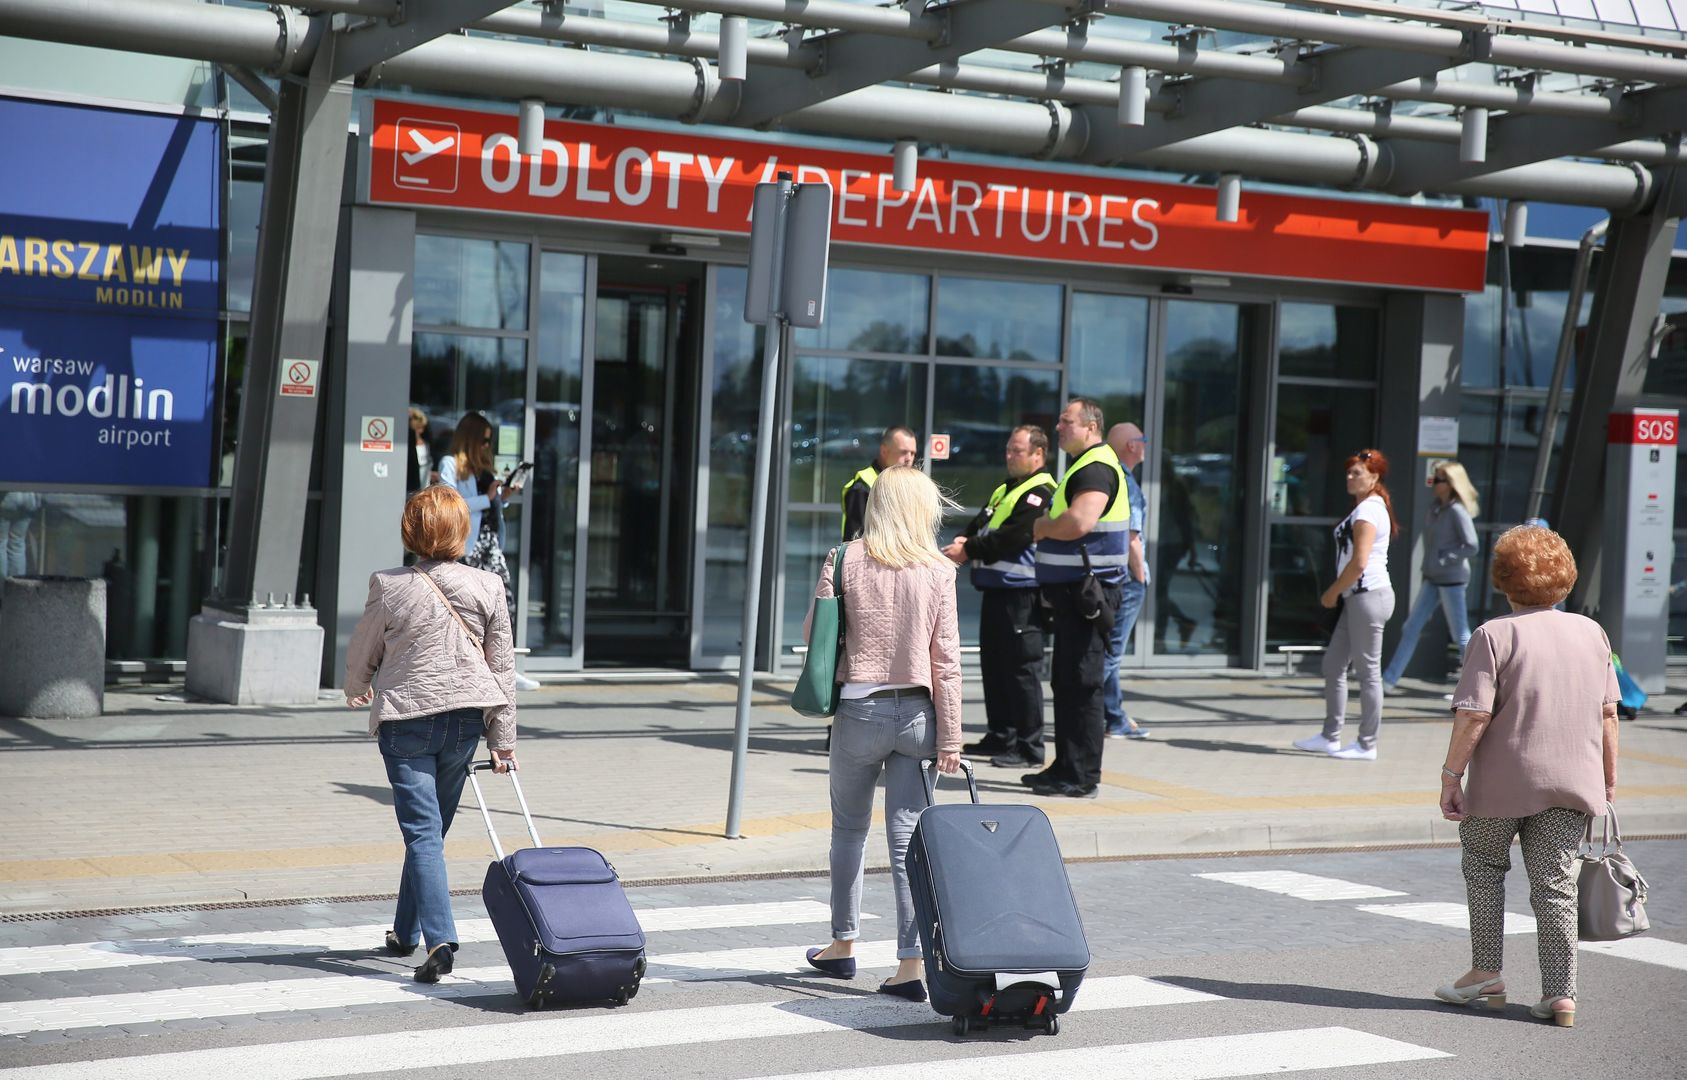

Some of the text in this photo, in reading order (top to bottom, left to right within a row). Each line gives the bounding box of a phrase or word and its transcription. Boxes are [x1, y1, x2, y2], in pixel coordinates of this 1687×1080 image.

[480, 132, 735, 213] ODLOTY
[96, 286, 183, 309] MODLIN
[13, 356, 94, 376] warsaw
[11, 373, 173, 421] modlin
[98, 425, 171, 450] airport
[1637, 419, 1675, 441] SOS
